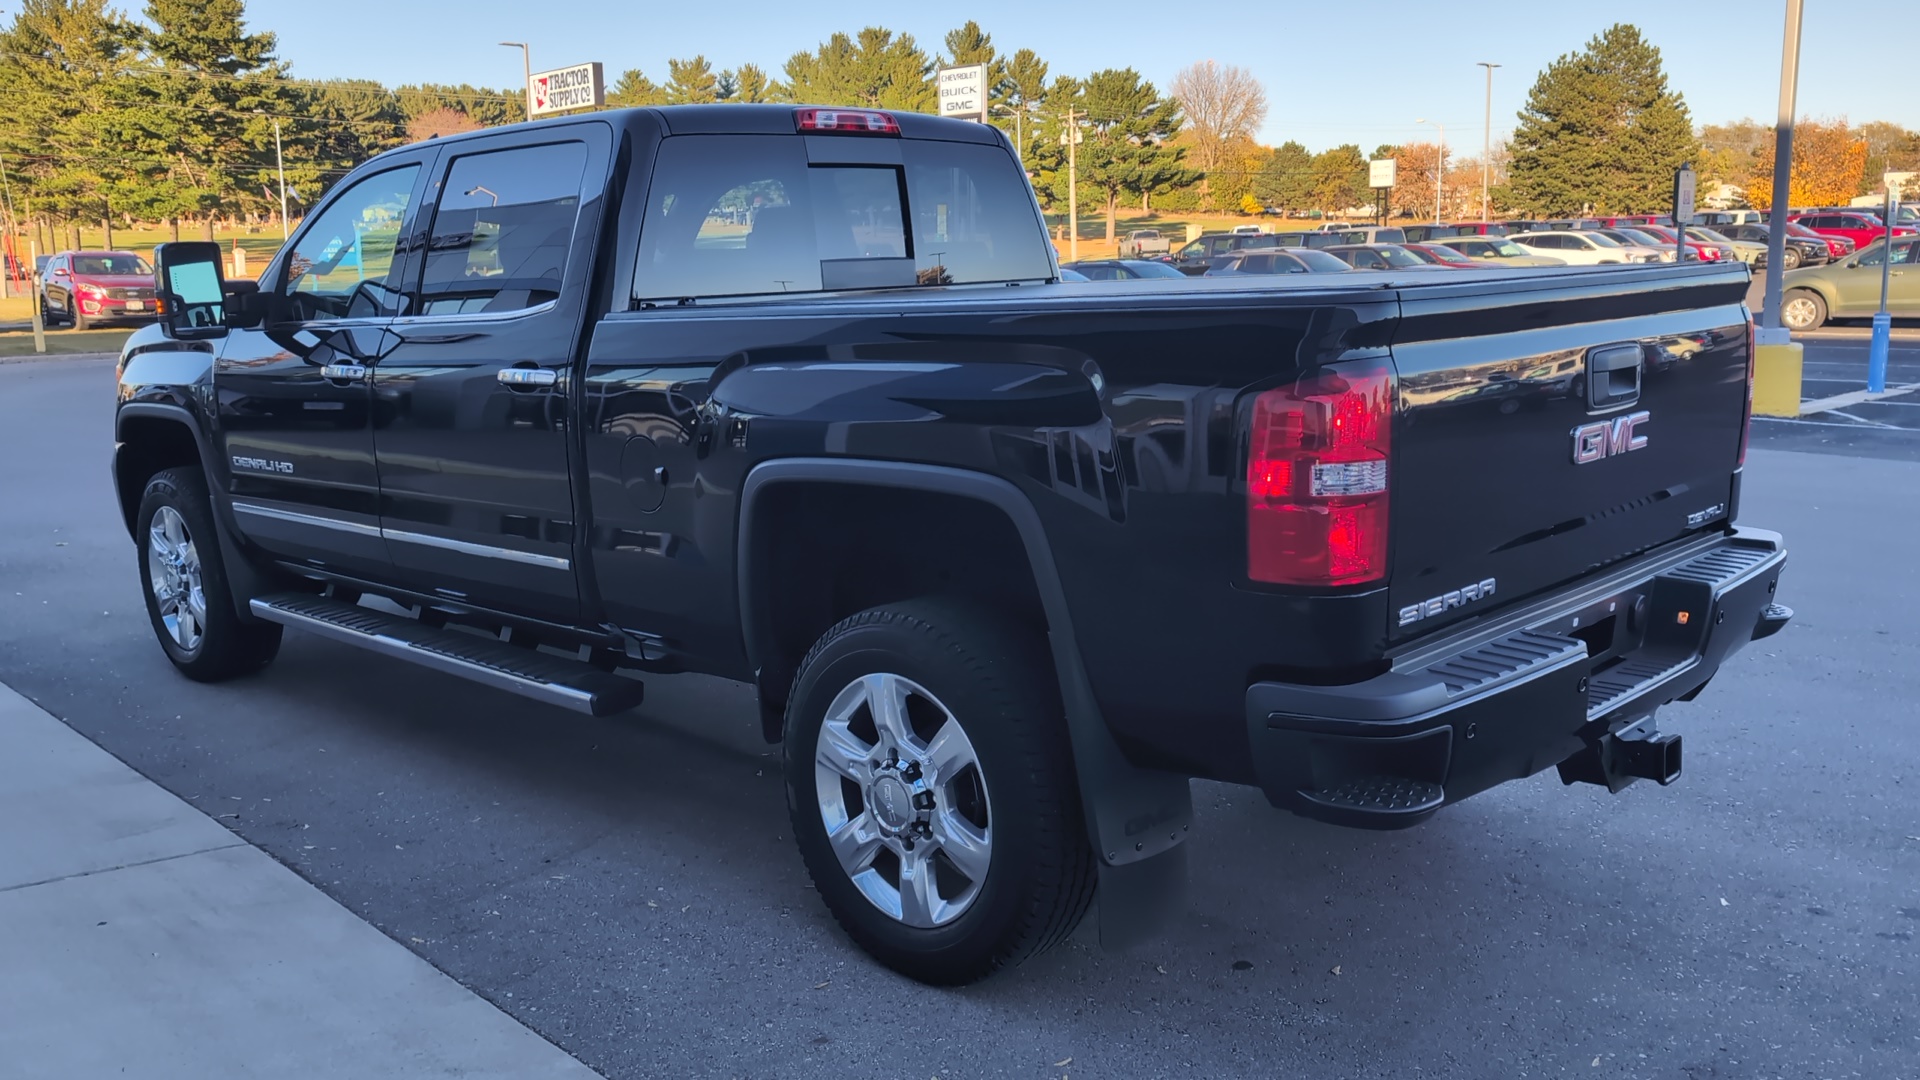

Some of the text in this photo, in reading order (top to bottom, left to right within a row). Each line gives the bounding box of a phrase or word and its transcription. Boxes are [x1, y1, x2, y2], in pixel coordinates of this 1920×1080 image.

[548, 68, 590, 91] TRACTOR
[941, 71, 977, 82] CHEVROLET
[549, 87, 580, 109] SUPPLY
[941, 86, 977, 97] BUICK
[946, 100, 973, 111] GMC
[1571, 410, 1651, 464] GMC
[232, 456, 294, 473] DENALI HD
[1398, 577, 1496, 627] SIERRA
